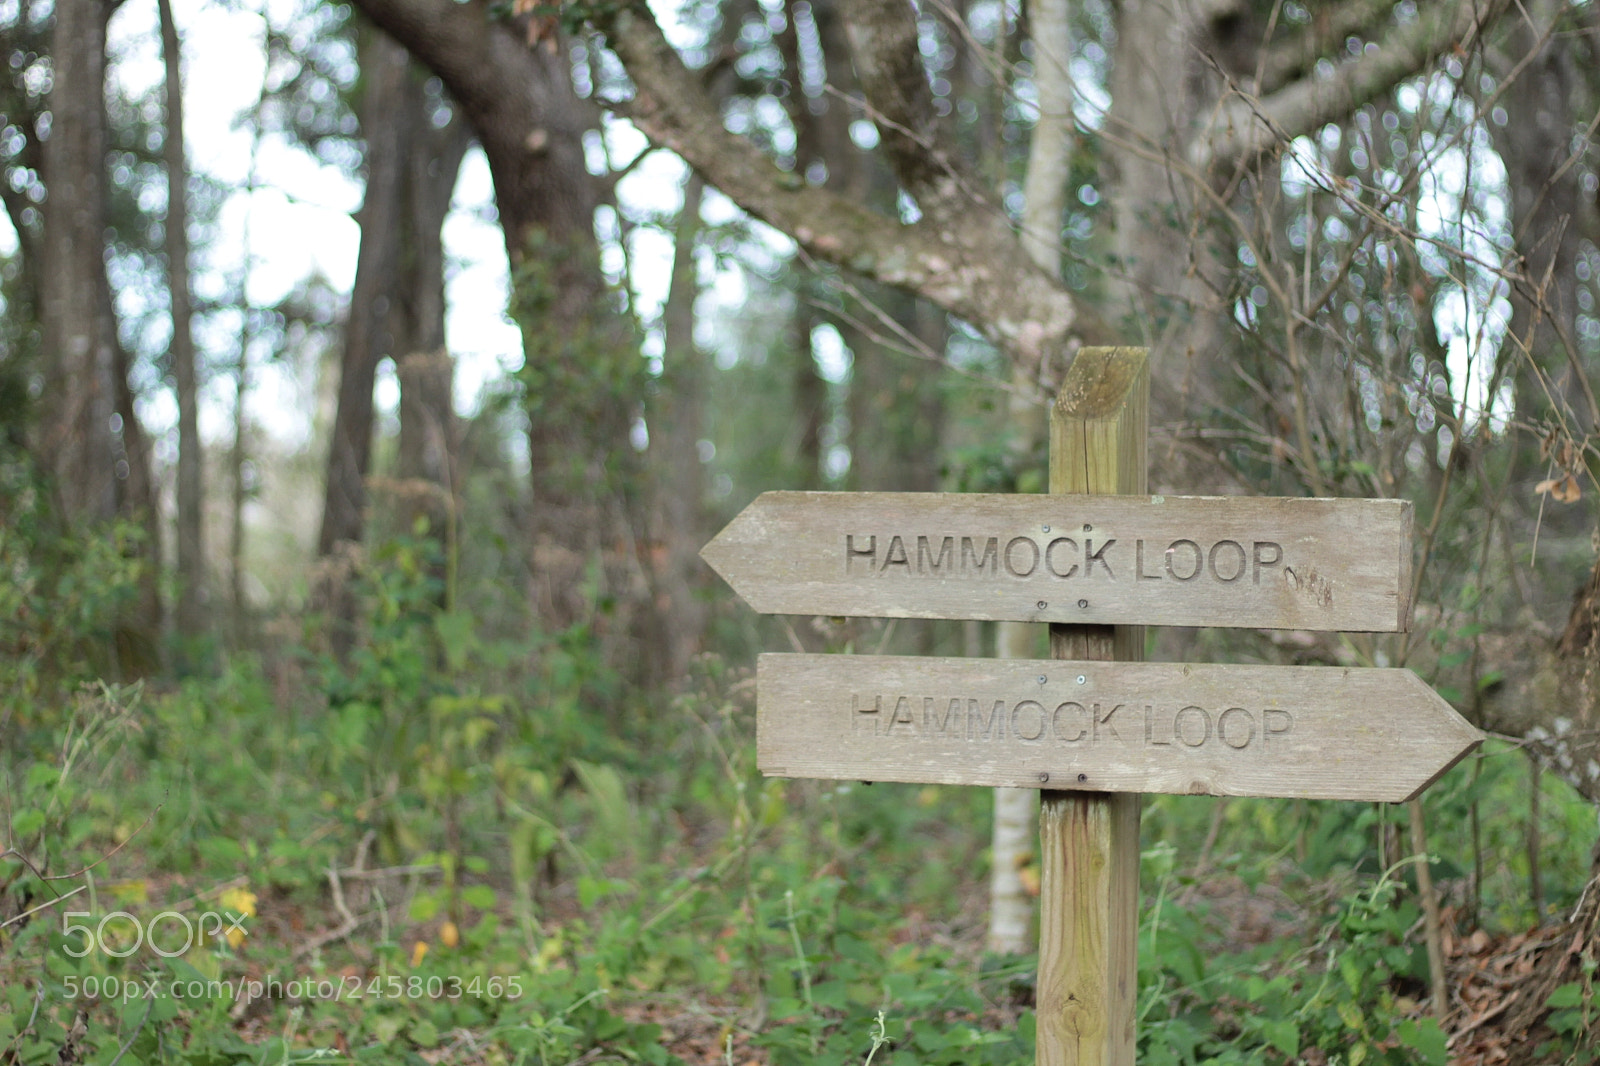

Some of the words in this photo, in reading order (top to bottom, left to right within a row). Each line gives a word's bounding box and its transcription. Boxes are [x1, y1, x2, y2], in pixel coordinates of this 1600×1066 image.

[846, 533, 1117, 580] HAMMOCK
[1136, 538, 1284, 584] LOOP
[851, 694, 1125, 743] HAMMOCK
[1144, 705, 1294, 750] LOOP
